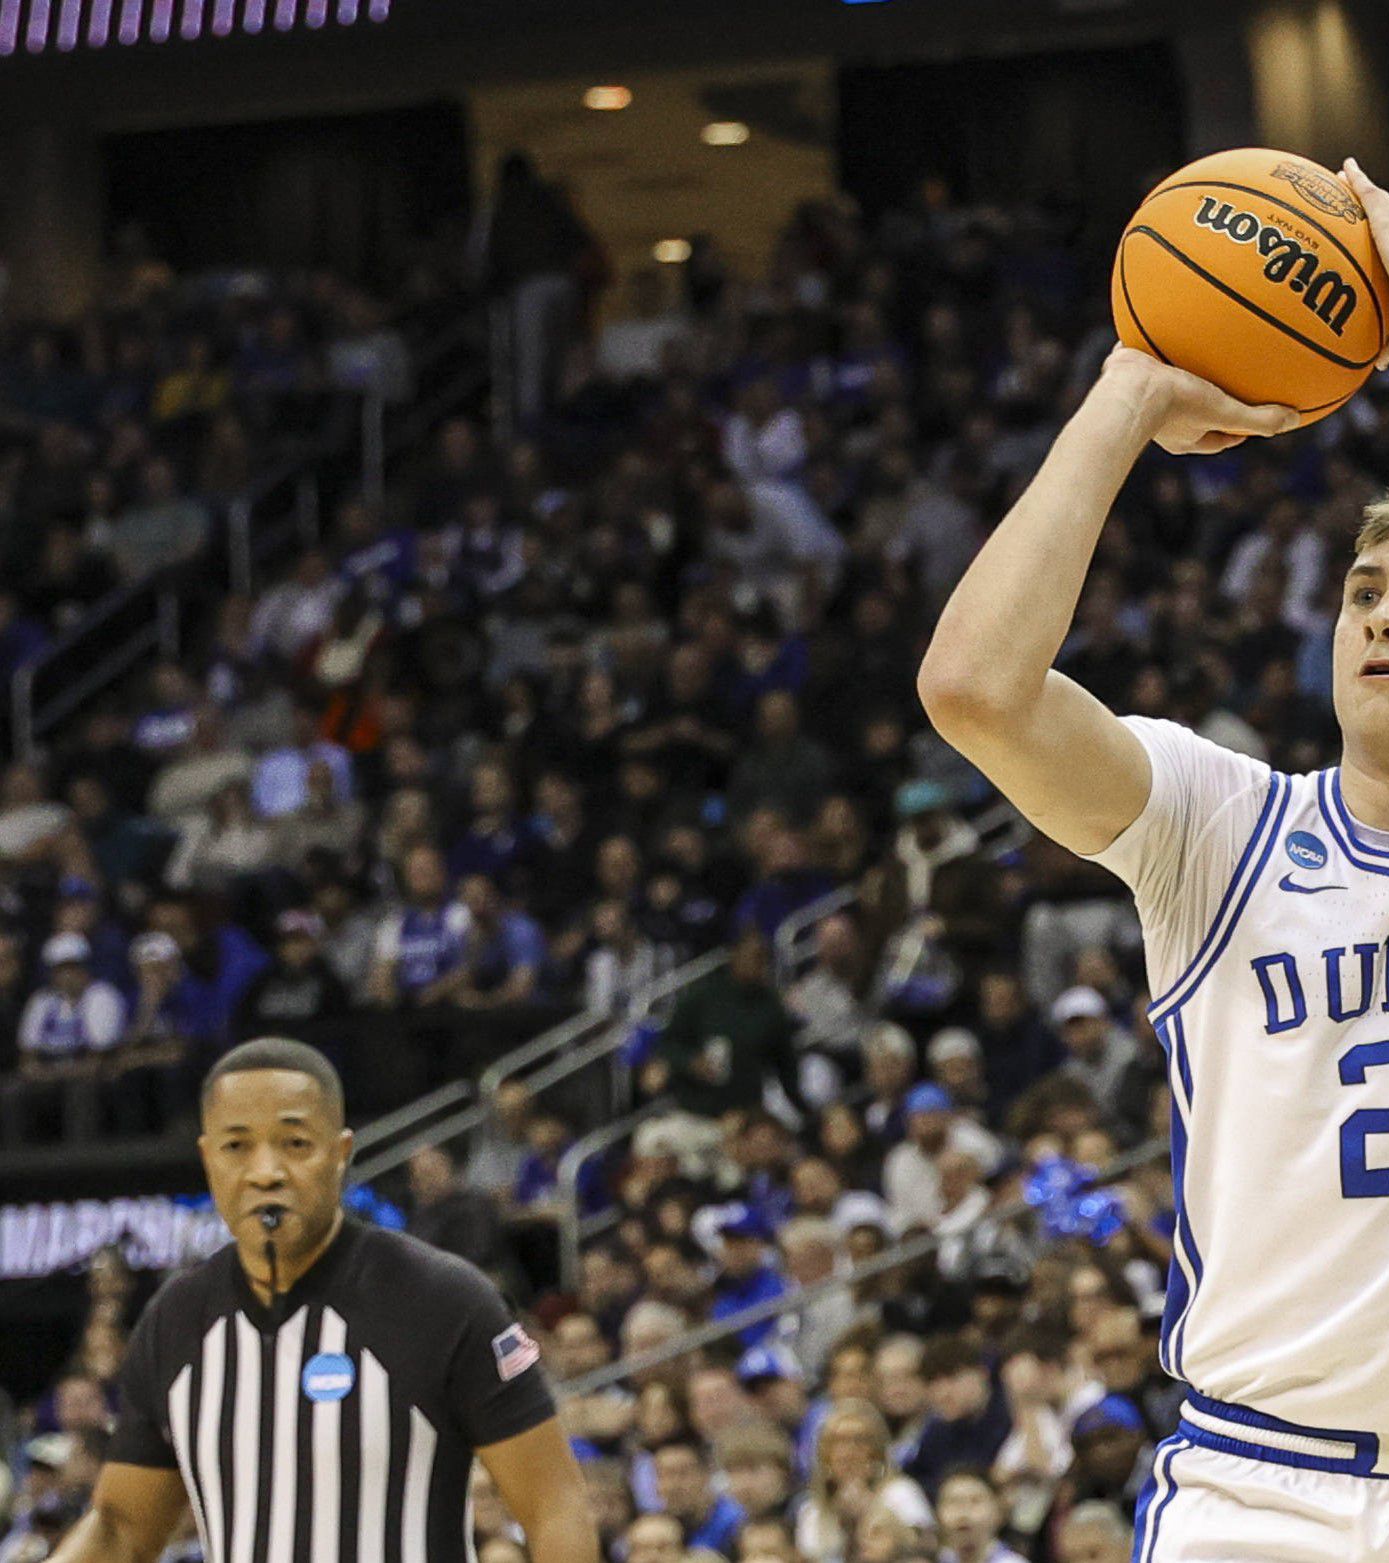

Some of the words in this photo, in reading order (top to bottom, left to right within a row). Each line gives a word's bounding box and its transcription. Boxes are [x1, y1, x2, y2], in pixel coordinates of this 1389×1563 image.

[1267, 213, 1292, 232] NXT
[1295, 230, 1320, 250] EVO
[1194, 195, 1357, 337] Wilson
[1288, 841, 1324, 865] NCAA
